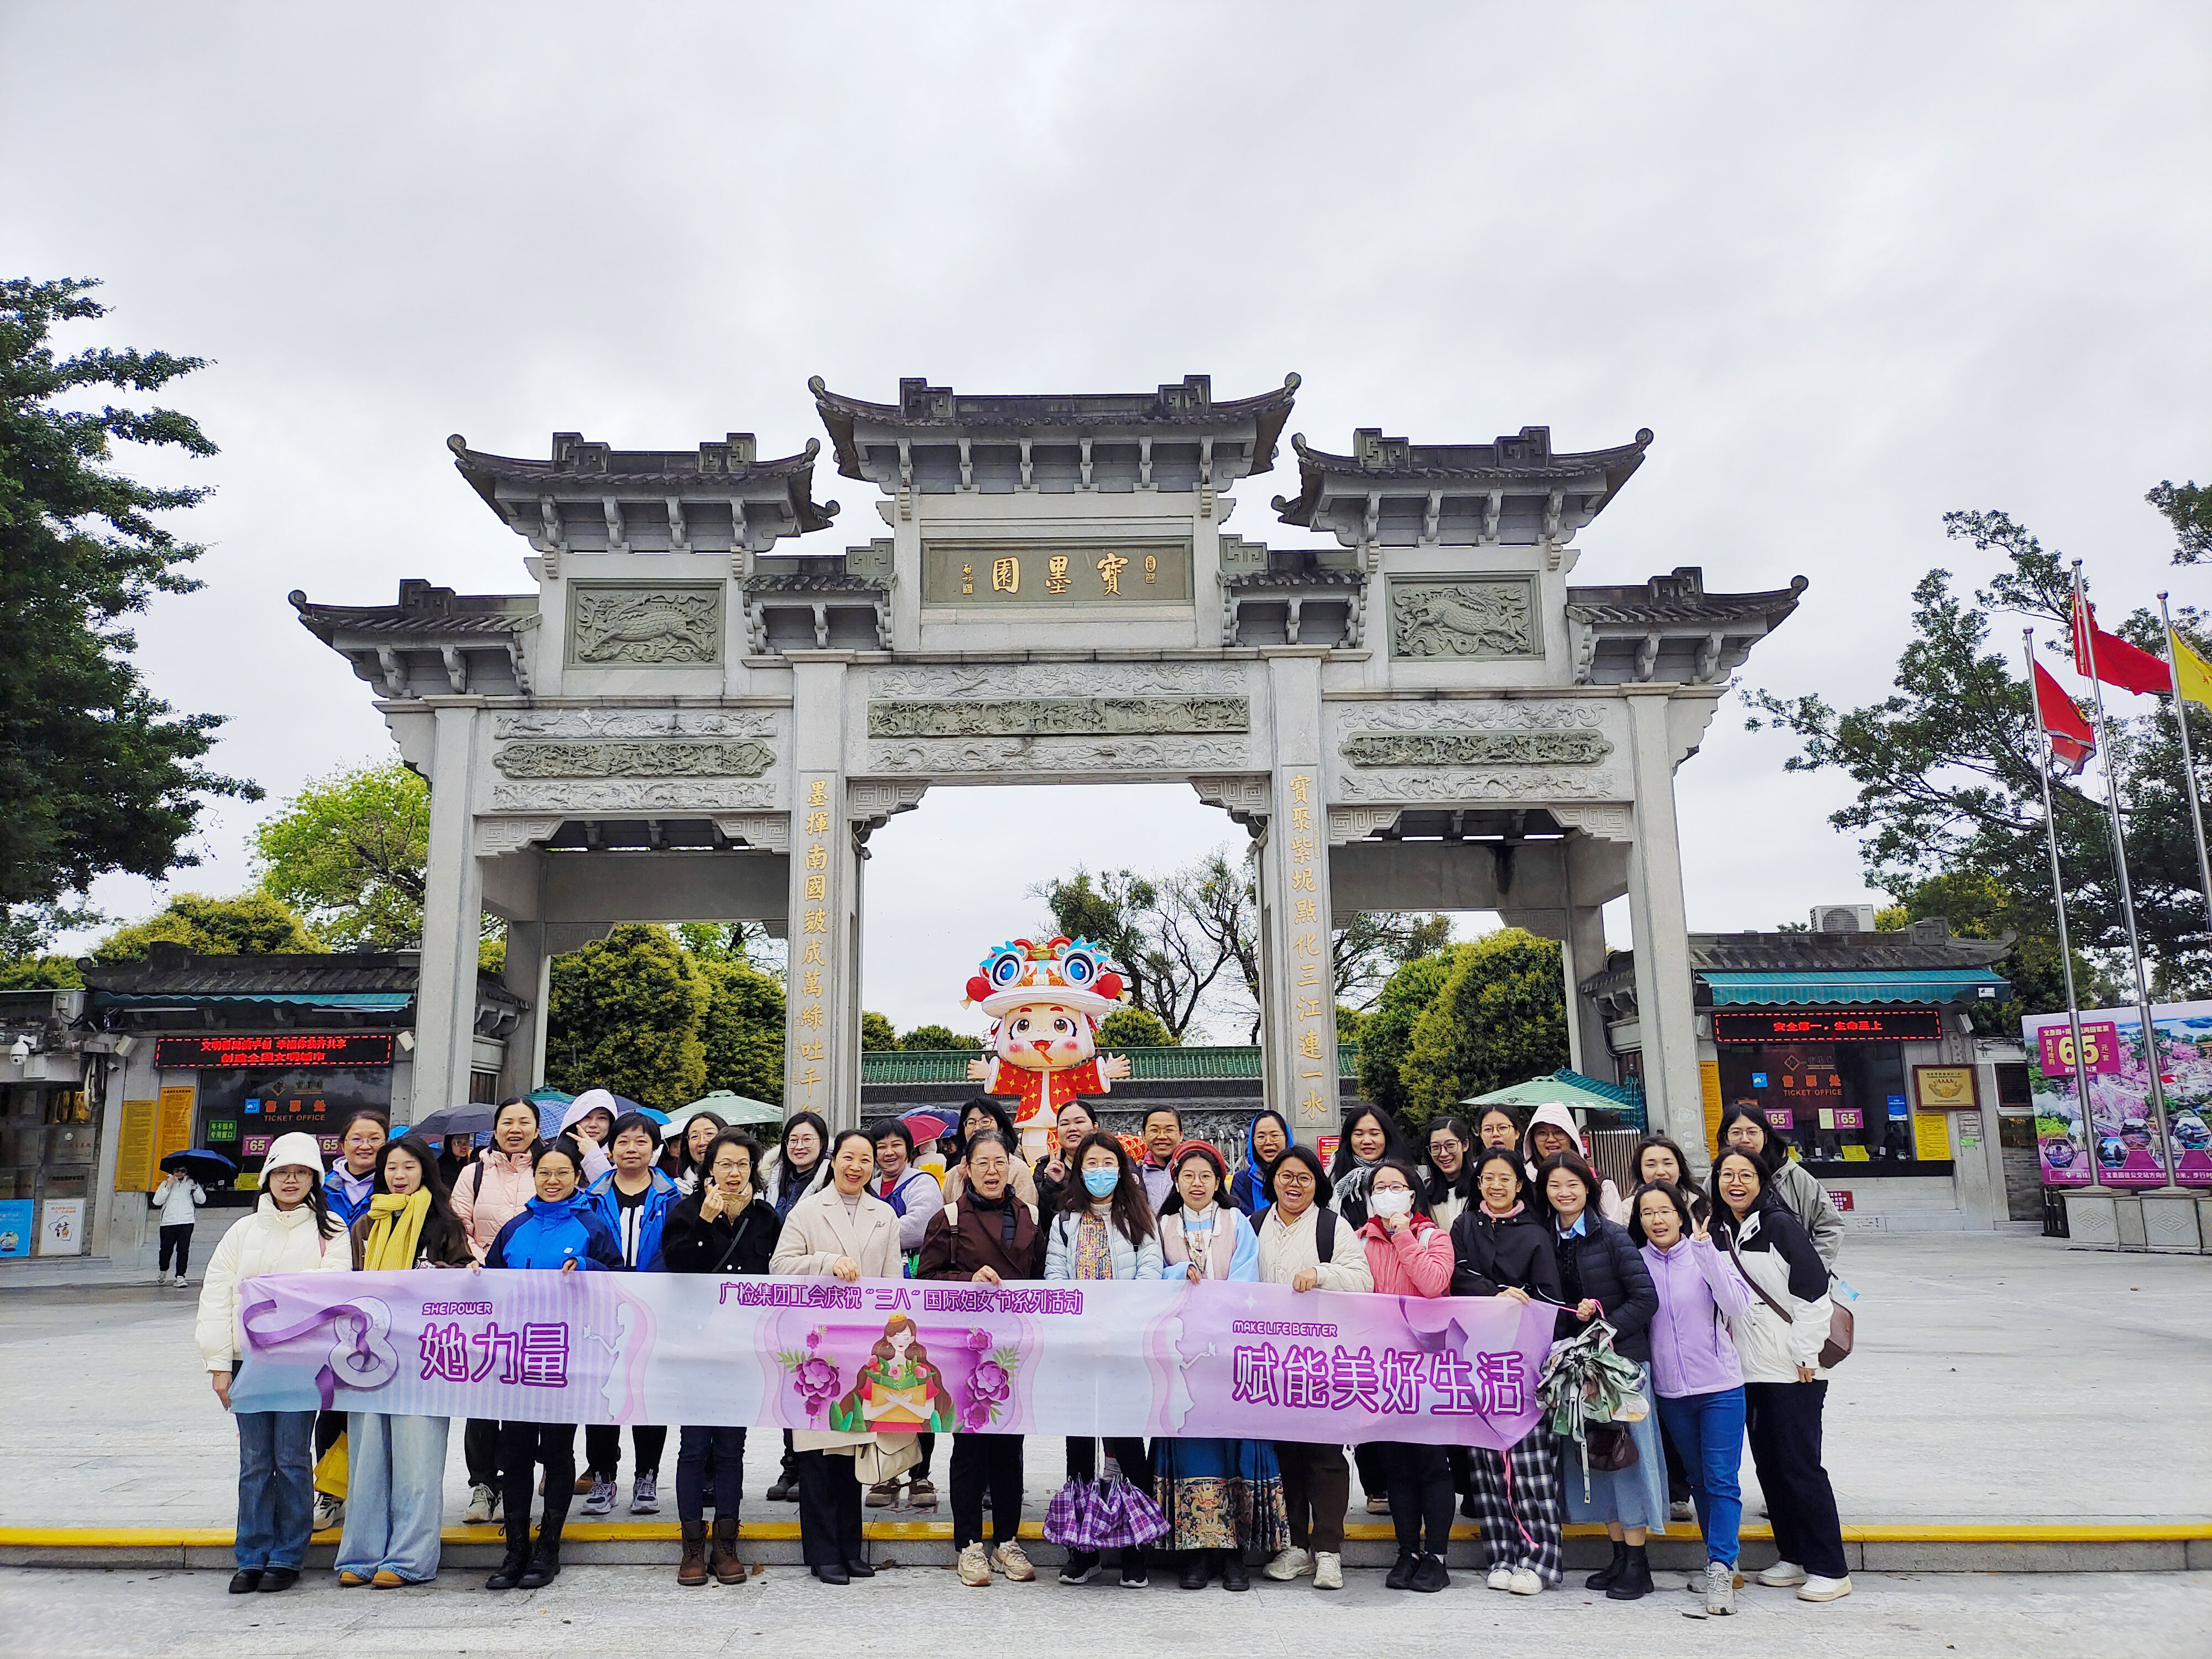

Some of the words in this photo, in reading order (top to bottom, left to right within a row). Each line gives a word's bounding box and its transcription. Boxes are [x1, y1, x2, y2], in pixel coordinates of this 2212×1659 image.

[221, 1052, 326, 1062] 创建全国文明城市
[2058, 1035, 2100, 1065] 65
[1782, 1074, 1841, 1088] 售票处
[265, 1099, 326, 1113] 售票处
[1770, 1113, 1786, 1125] 65
[1840, 1113, 1856, 1124] 65
[249, 1139, 265, 1151] 65
[323, 1139, 338, 1151] 65
[422, 1302, 447, 1315] SHE
[448, 1302, 493, 1316] POWER
[1233, 1320, 1266, 1334] MAKE
[1266, 1322, 1291, 1335] LIFE
[1291, 1322, 1338, 1337] BETTER
[420, 1322, 568, 1388] 她力量
[1232, 1342, 1525, 1416] 赋能美好生活
